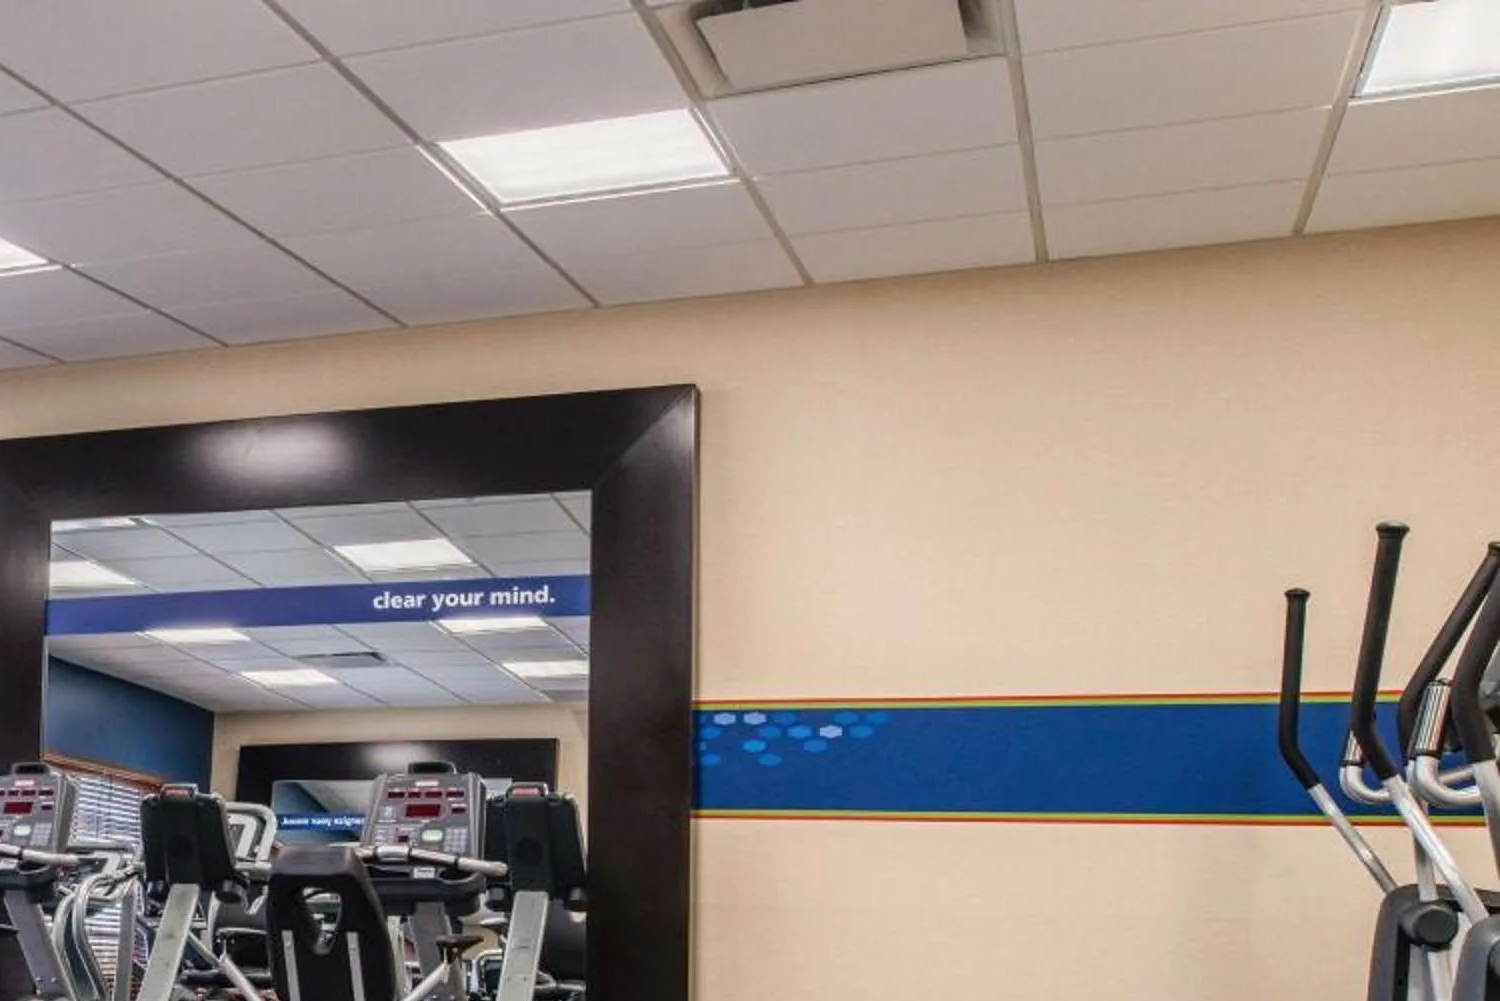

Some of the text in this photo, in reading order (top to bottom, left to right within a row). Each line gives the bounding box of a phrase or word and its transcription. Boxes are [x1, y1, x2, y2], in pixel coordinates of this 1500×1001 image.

[373, 584, 556, 612] clear your mind.
